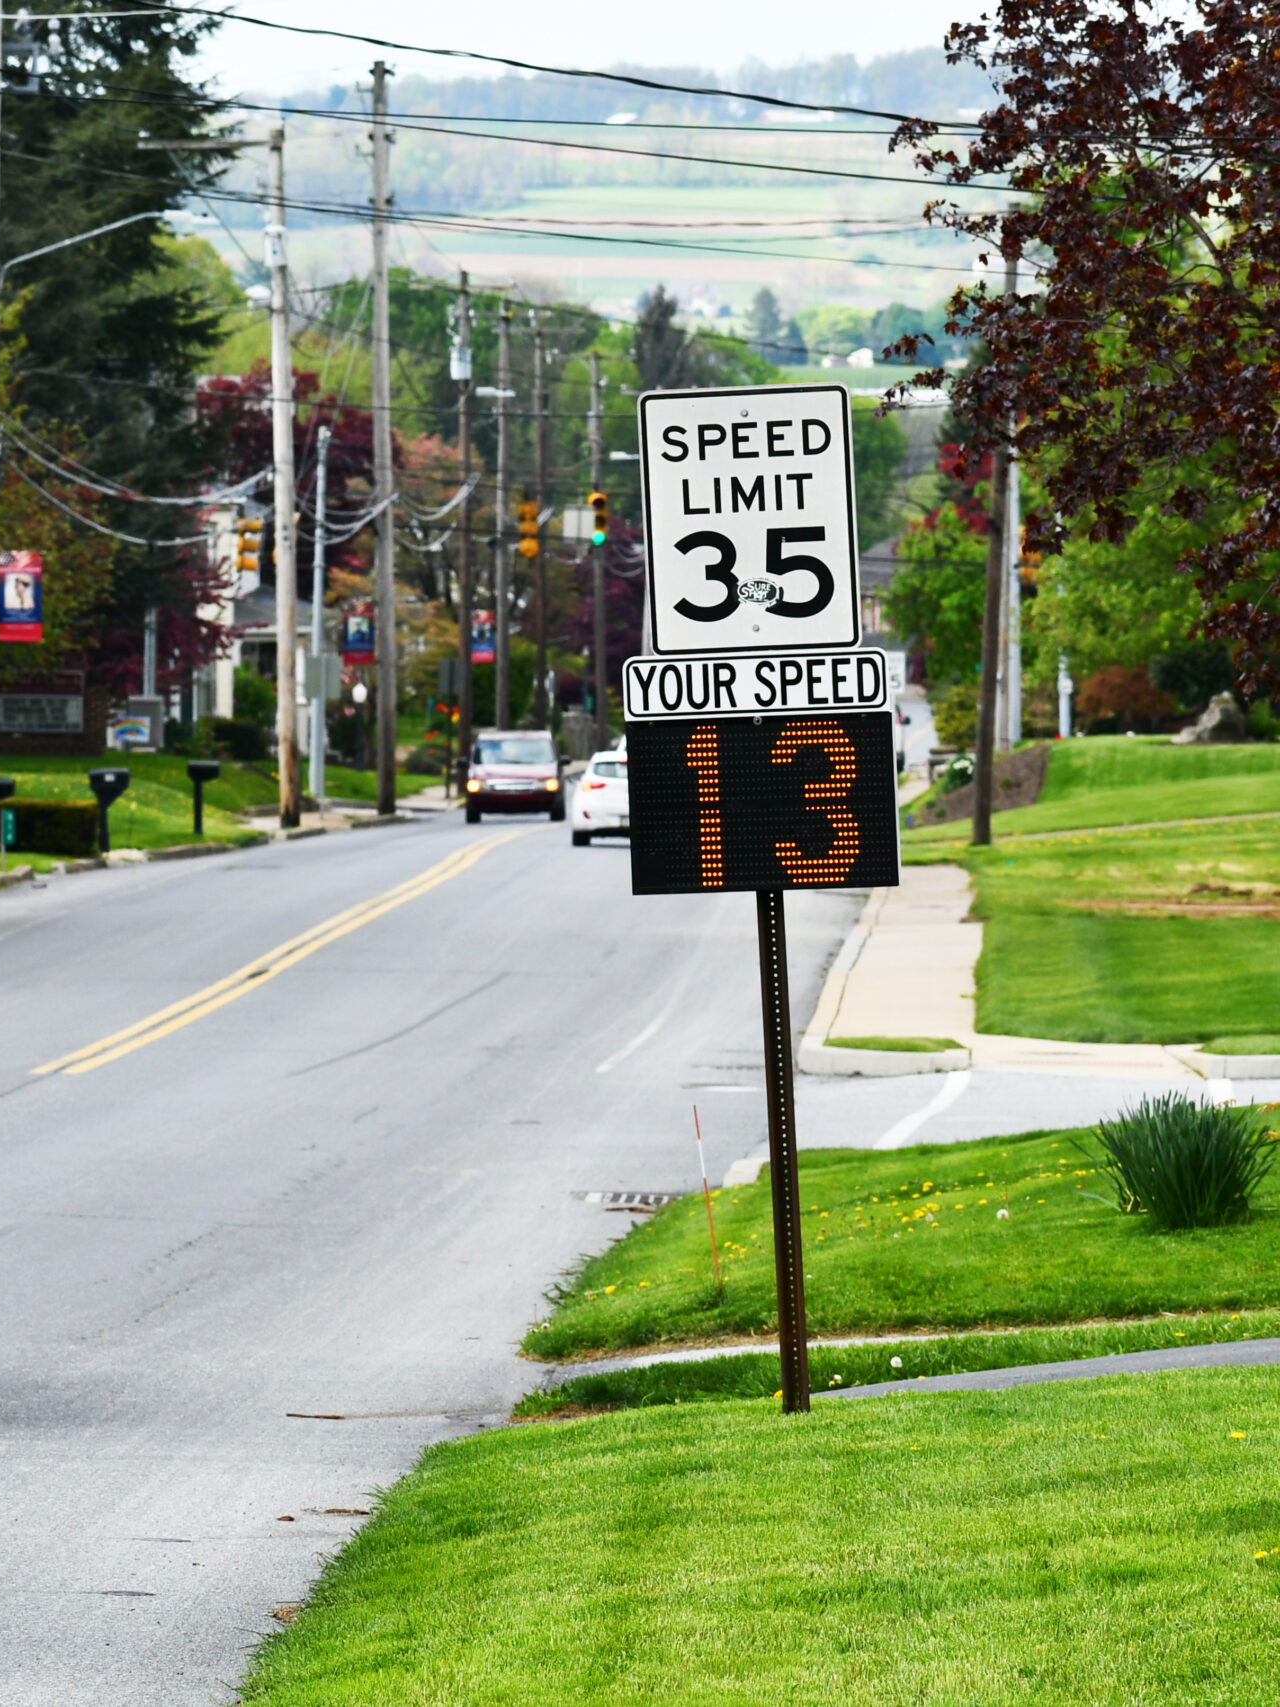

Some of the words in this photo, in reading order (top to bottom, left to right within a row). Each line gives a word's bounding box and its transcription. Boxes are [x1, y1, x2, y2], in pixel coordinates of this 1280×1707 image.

[662, 418, 832, 463] SPEED
[682, 472, 813, 516] LIMIT
[673, 525, 835, 623] 35
[632, 662, 738, 712] YOUR
[754, 656, 881, 708] SPEED
[685, 720, 861, 887] 13
